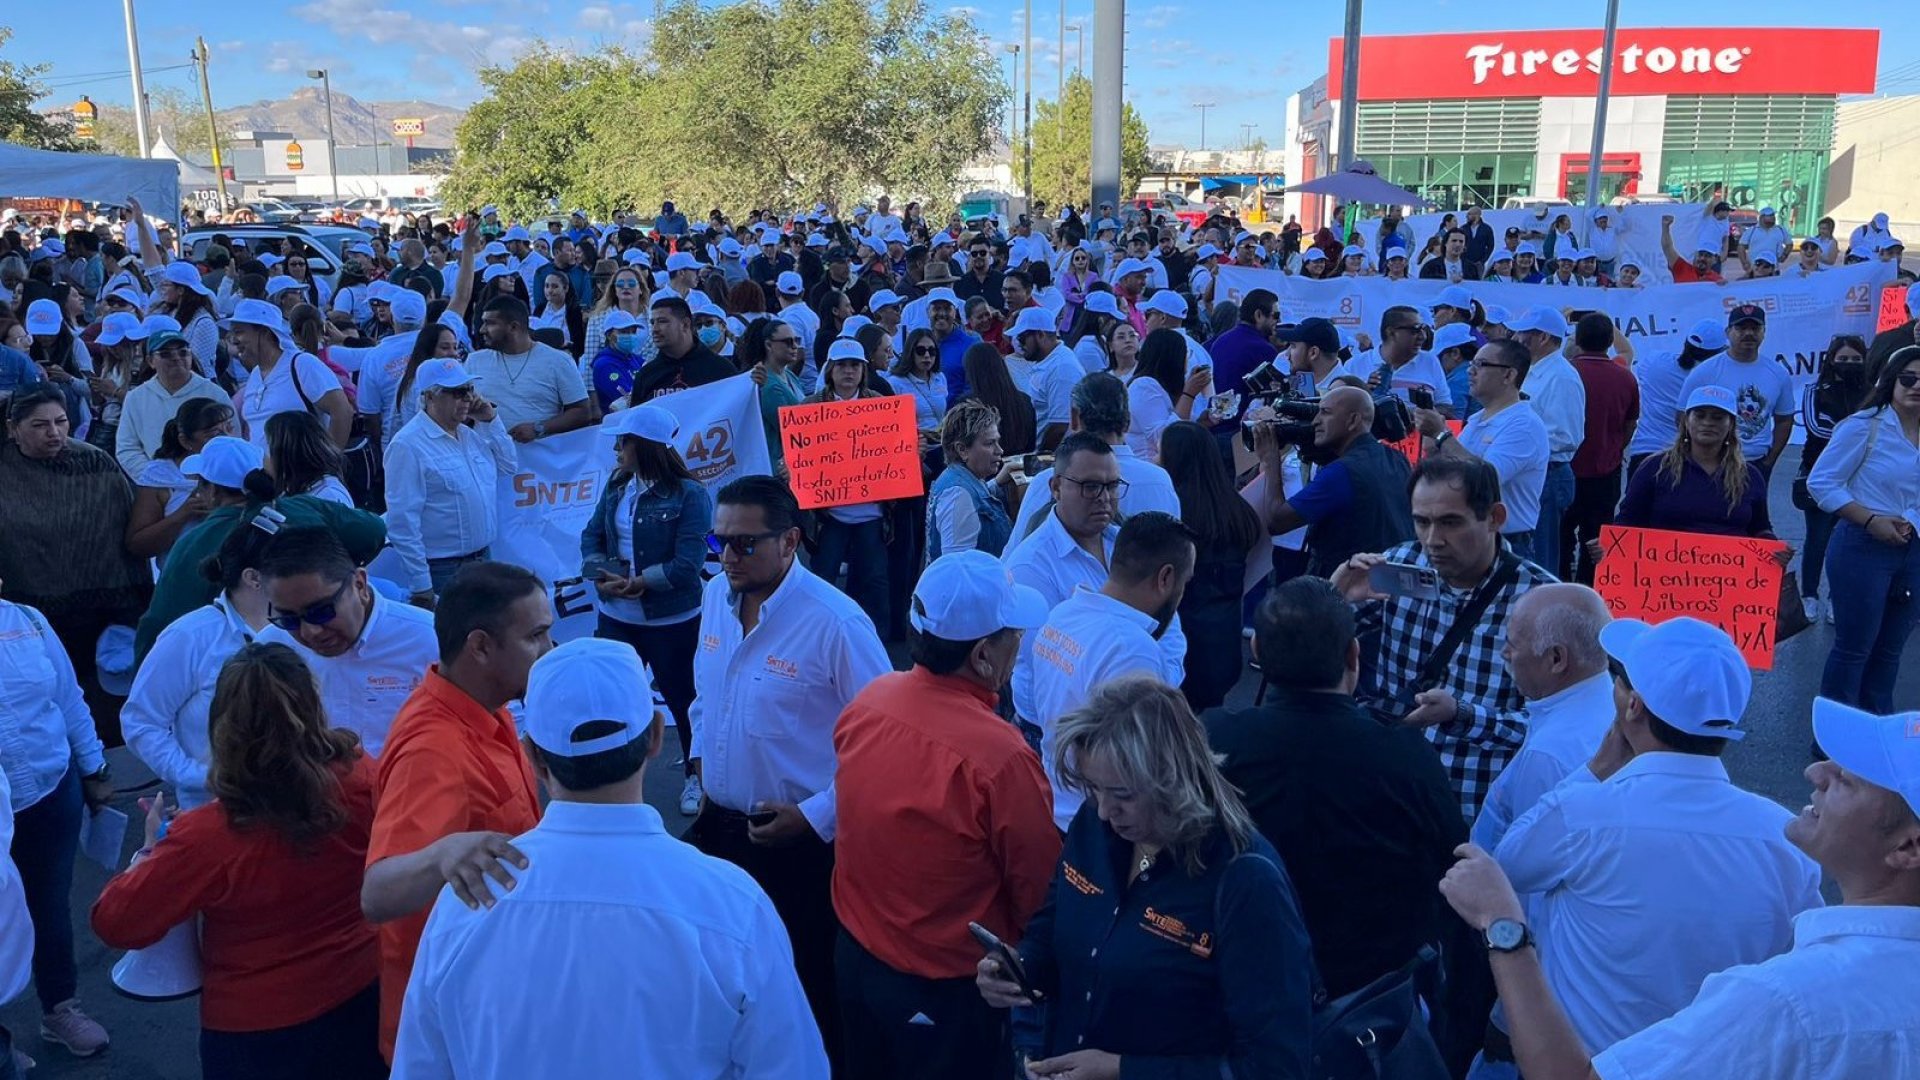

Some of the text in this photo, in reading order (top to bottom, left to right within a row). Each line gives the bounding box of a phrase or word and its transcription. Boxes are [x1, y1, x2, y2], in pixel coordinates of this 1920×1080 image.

[1465, 42, 1743, 85] Firestone
[1845, 285, 1869, 302] 42
[685, 427, 732, 461] 42
[790, 423, 899, 449] No me quieren
[793, 440, 913, 469] dar mis libros de
[513, 473, 594, 508] SNTE
[860, 484, 870, 498] 8
[1606, 529, 1744, 569] X la defensa
[1598, 562, 1769, 598] de la entrega de
[1641, 590, 1719, 613] Libros
